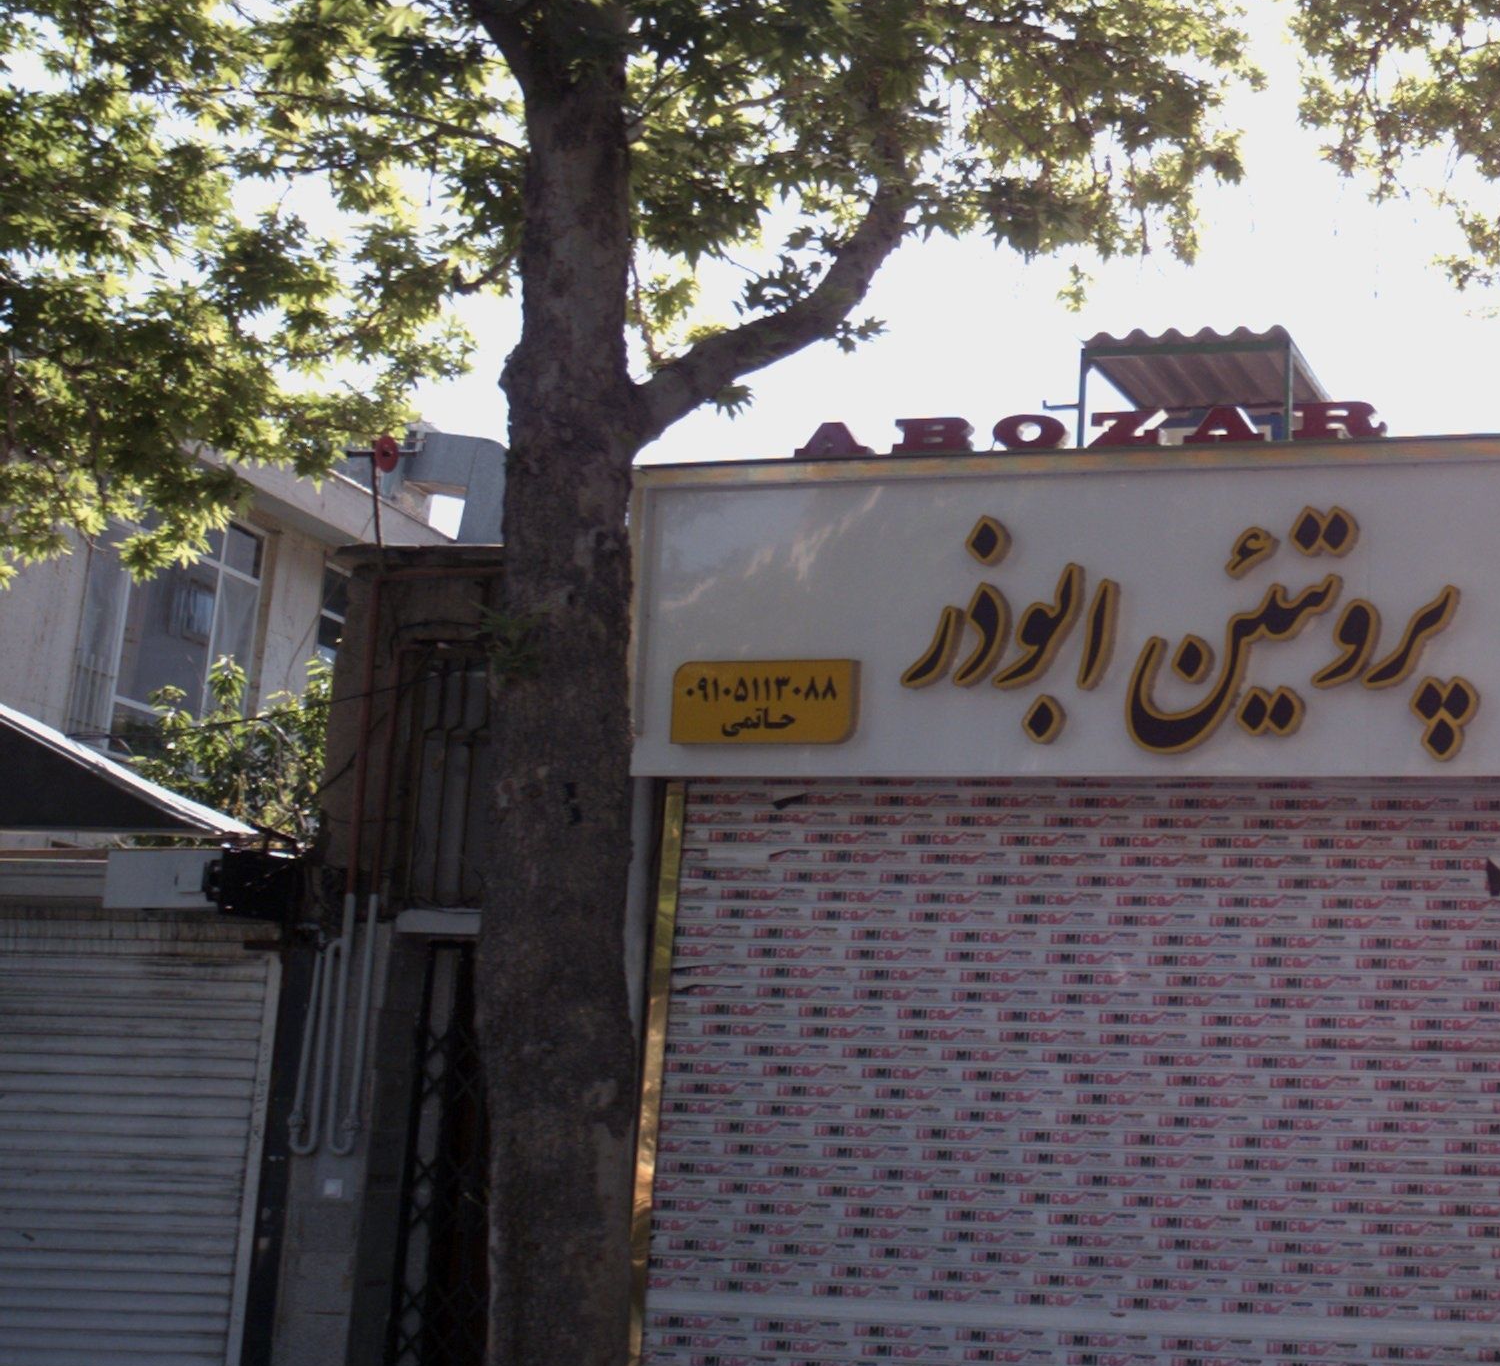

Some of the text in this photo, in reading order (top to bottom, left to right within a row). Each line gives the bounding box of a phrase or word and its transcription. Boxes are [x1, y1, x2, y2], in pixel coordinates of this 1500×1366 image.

[793, 401, 1388, 458] ABOZAR
[900, 505, 1480, 762] پروتئین ابوذر
[686, 676, 837, 702] ۰۹۱۰۵۱۱۳۰۸۸
[722, 707, 796, 736] حاتمی
[946, 815, 993, 827] LUMICO
[1143, 817, 1192, 829] LUMICO
[1345, 819, 1396, 831] LUMICO
[901, 834, 950, 845] LUMICO
[1100, 836, 1149, 848] LUMICO
[1303, 838, 1354, 849] LUMICO
[1120, 856, 1170, 867] LUMICO
[1326, 858, 1376, 869] LUMICO
[783, 871, 830, 883] LUMICO
[977, 874, 1026, 886] LUMICO
[1176, 877, 1226, 888] LUMICO
[1381, 879, 1432, 891] LUMICO
[818, 891, 865, 902] LUMICO
[1016, 894, 1064, 905] LUMICO
[1218, 896, 1269, 908] LUMICO
[1426, 899, 1477, 911] LUMICO
[716, 908, 762, 920] LUMICO
[909, 911, 958, 923] LUMICO
[1108, 915, 1157, 926] LUMICO
[1312, 917, 1363, 929] LUMICO
[851, 929, 900, 941] LUMICO
[1050, 933, 1100, 945] LUMICO
[1256, 936, 1306, 948] LUMICO
[748, 947, 794, 959] LUMICO
[944, 951, 994, 963] LUMICO
[1147, 955, 1198, 966] LUMICO
[1356, 958, 1406, 970] LUMICO
[859, 969, 908, 981] LUMICO
[1062, 973, 1113, 985] LUMICO
[1270, 977, 1322, 989] LUMICO
[756, 987, 804, 998] LUMICO
[952, 991, 1000, 1003] LUMICO
[1153, 995, 1202, 1007] LUMICO
[1358, 999, 1410, 1011] LUMICO
[798, 1006, 846, 1018] LUMICO
[998, 1011, 1046, 1022] LUMICO
[1201, 1015, 1252, 1027] LUMICO
[1410, 1019, 1461, 1031] LUMICO
[702, 1024, 749, 1036] LUMICO
[898, 1029, 948, 1041] LUMICO
[1100, 1033, 1148, 1046] LUMICO
[1306, 1038, 1356, 1050] LUMICO
[842, 1047, 891, 1059] LUMICO
[1042, 1052, 1091, 1064] LUMICO
[1246, 1057, 1298, 1068] LUMICO
[862, 1067, 910, 1079] LUMICO
[1064, 1073, 1113, 1084] LUMICO
[1270, 1077, 1320, 1089] LUMICO
[777, 1085, 824, 1097] LUMICO
[976, 1091, 1024, 1102] LUMICO
[1178, 1096, 1230, 1108] LUMICO
[1388, 1101, 1438, 1112] LUMICO
[854, 1108, 904, 1119] LUMICO
[1055, 1113, 1106, 1125] LUMICO
[814, 1125, 864, 1137] LUMICO
[1262, 1119, 1313, 1131] LUMICO
[1019, 1131, 1070, 1143] LUMICO
[1229, 1136, 1282, 1149] LUMICO
[724, 1143, 772, 1156] LUMICO
[922, 1149, 971, 1162] LUMICO
[1124, 1155, 1176, 1168] LUMICO
[1332, 1161, 1386, 1173] LUMICO
[768, 1165, 819, 1178] LUMICO
[975, 1172, 1024, 1184] LUMICO
[1180, 1178, 1231, 1190] LUMICO
[719, 1182, 766, 1194] LUMICO
[1391, 1184, 1444, 1195] LUMICO
[918, 1189, 967, 1201] LUMICO
[1122, 1195, 1174, 1208] LUMICO
[845, 1206, 894, 1219] LUMICO
[1332, 1202, 1384, 1214] LUMICO
[1047, 1213, 1098, 1226] LUMICO
[734, 1222, 784, 1235] LUMICO
[1255, 1220, 1308, 1232] LUMICO
[942, 1231, 995, 1243] LUMICO
[769, 1243, 818, 1256] LUMICO
[1158, 1239, 1211, 1251] LUMICO
[971, 1251, 1020, 1264] LUMICO
[1379, 1246, 1434, 1257] LUMICO
[1177, 1259, 1228, 1271] LUMICO
[932, 1270, 981, 1283] LUMICO
[1388, 1266, 1440, 1278] LUMICO
[1137, 1278, 1188, 1291] LUMICO
[812, 1285, 862, 1297] LUMICO
[1348, 1286, 1400, 1298] LUMICO
[1014, 1294, 1065, 1306] LUMICO
[1222, 1302, 1273, 1314] LUMICO
[654, 1316, 703, 1329] LUMICO
[854, 1325, 903, 1338] LUMICO
[761, 1340, 810, 1353] LUMICO
[1058, 1334, 1108, 1347] LUMICO
[1266, 1343, 1318, 1355] LUMICO
[963, 1349, 1014, 1362] LUMICO
